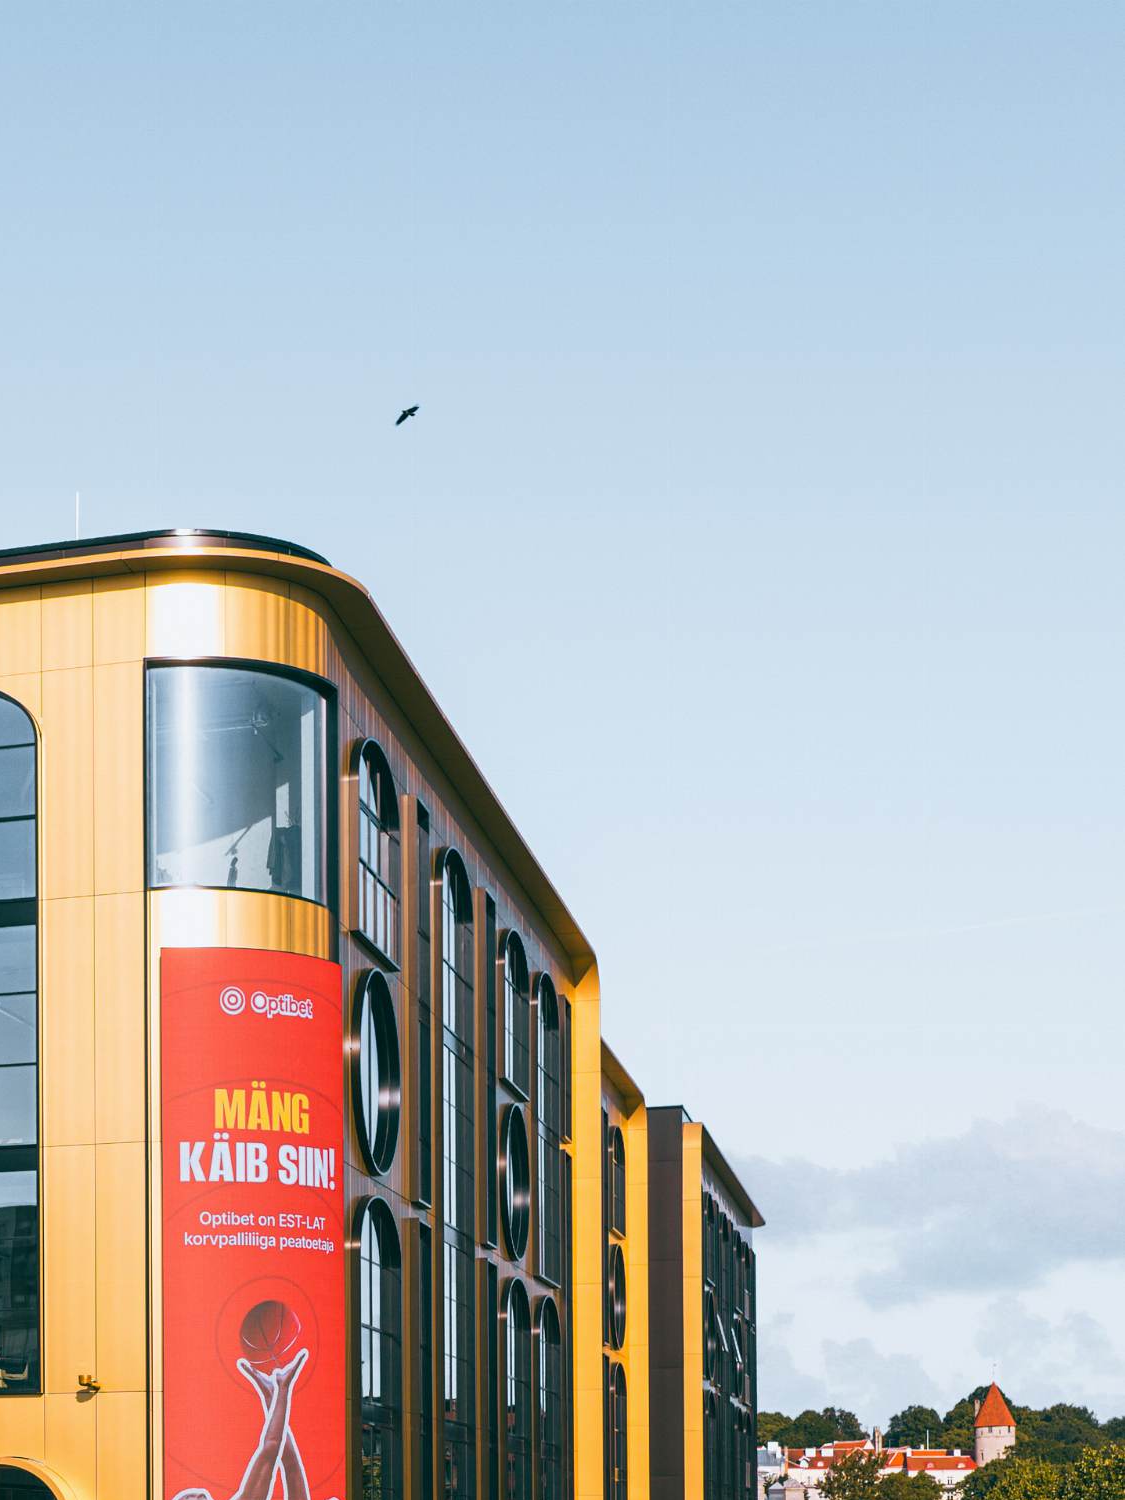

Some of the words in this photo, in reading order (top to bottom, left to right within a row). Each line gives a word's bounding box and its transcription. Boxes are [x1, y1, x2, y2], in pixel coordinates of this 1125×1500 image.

[251, 991, 313, 1019] Optibet
[214, 1081, 310, 1134] MÄNG
[179, 1132, 269, 1182] KÄIB
[278, 1144, 336, 1190] SIIN!
[199, 1211, 255, 1228] Optibet
[258, 1216, 275, 1227] on
[279, 1213, 326, 1230] EST-LAT
[184, 1232, 276, 1250] korvpalliliiga
[280, 1235, 334, 1254] peatoetaja
